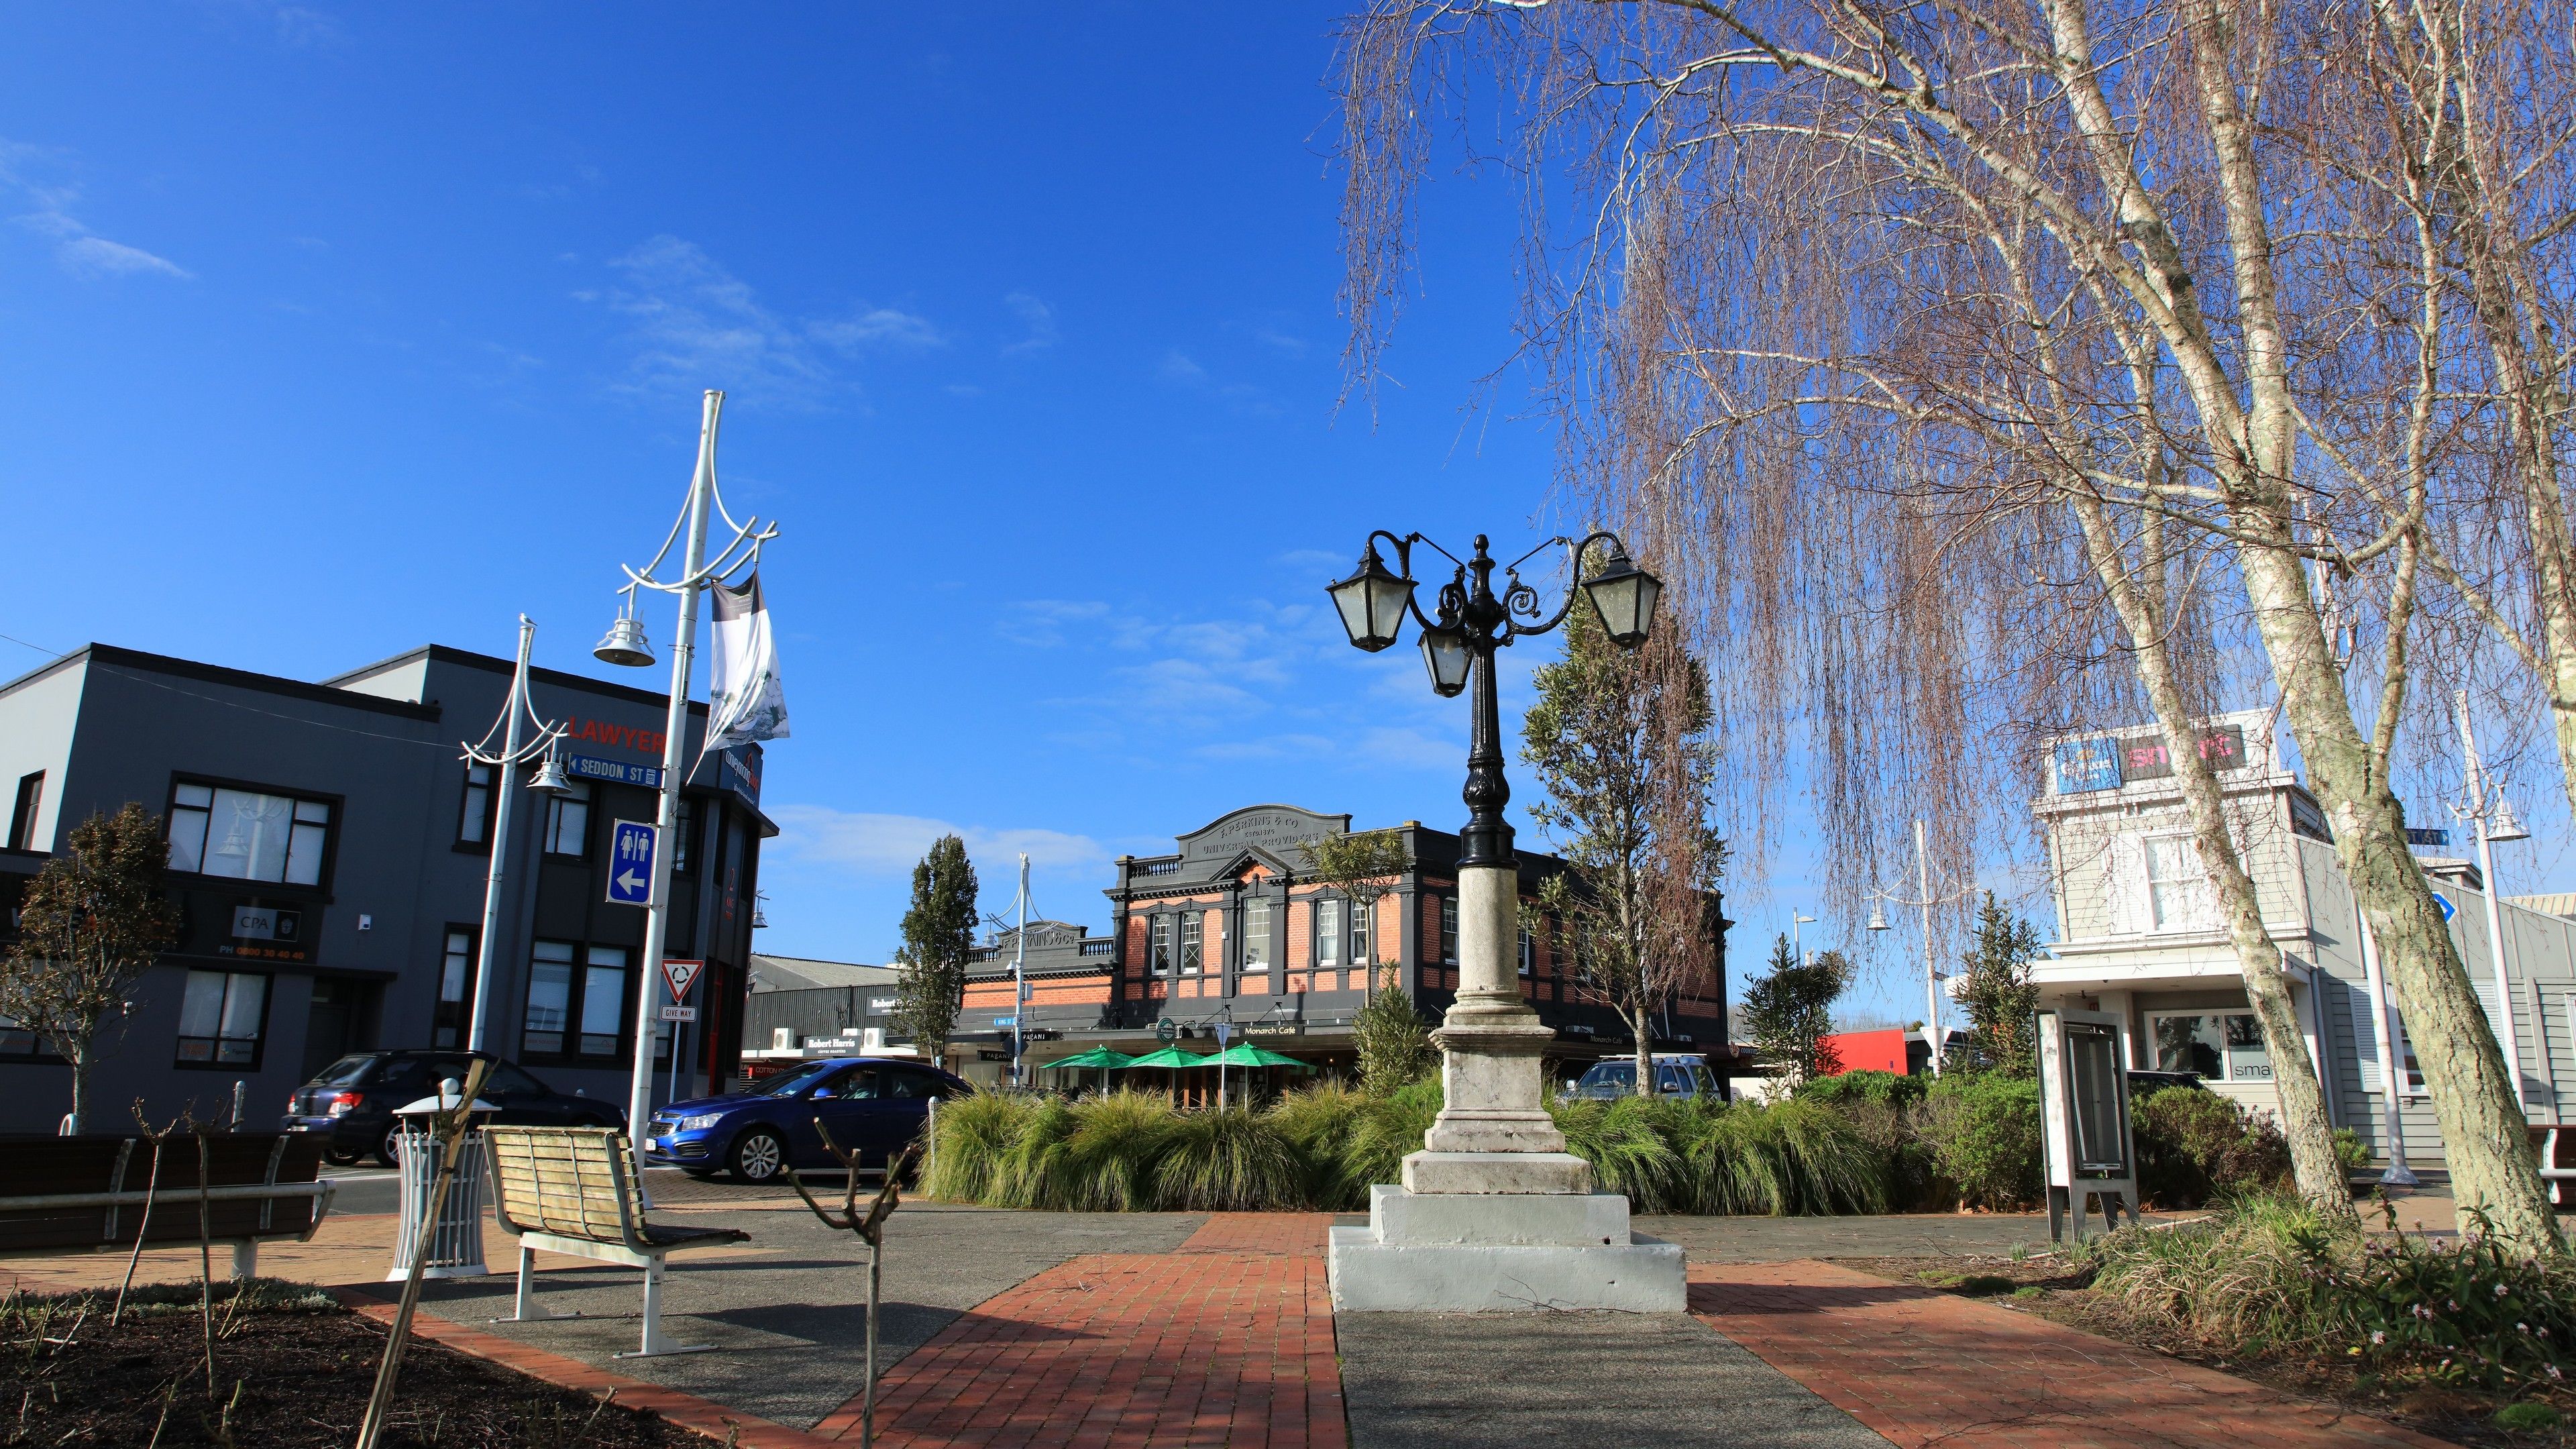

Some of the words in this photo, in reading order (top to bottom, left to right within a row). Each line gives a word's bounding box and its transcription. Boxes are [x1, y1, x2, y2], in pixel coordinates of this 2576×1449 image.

[2128, 733, 2233, 768] smrt
[581, 759, 625, 779] SEDDON
[630, 767, 644, 782] ST
[1229, 816, 1271, 835] PERKINS
[1275, 816, 1281, 825] &
[1203, 840, 1255, 854] UNIVERSAL
[1262, 833, 1319, 847] PROVIDERS
[241, 916, 269, 930] CPA
[1012, 929, 1055, 948] PRKINS
[219, 945, 234, 954] PH
[235, 946, 261, 956] 0800
[263, 948, 275, 958] 30
[277, 949, 290, 959] 40
[291, 951, 305, 961] 40
[872, 998, 896, 1008] Robert
[665, 1009, 678, 1017] GIVE
[680, 1010, 692, 1018] WAY
[1245, 1026, 1277, 1035] Monarch
[1278, 1026, 1296, 1035] Café
[808, 1038, 832, 1048] Robert
[833, 1038, 855, 1048] Harris
[1590, 1035, 1611, 1043] Monarch
[2235, 1065, 2271, 1076] sma
